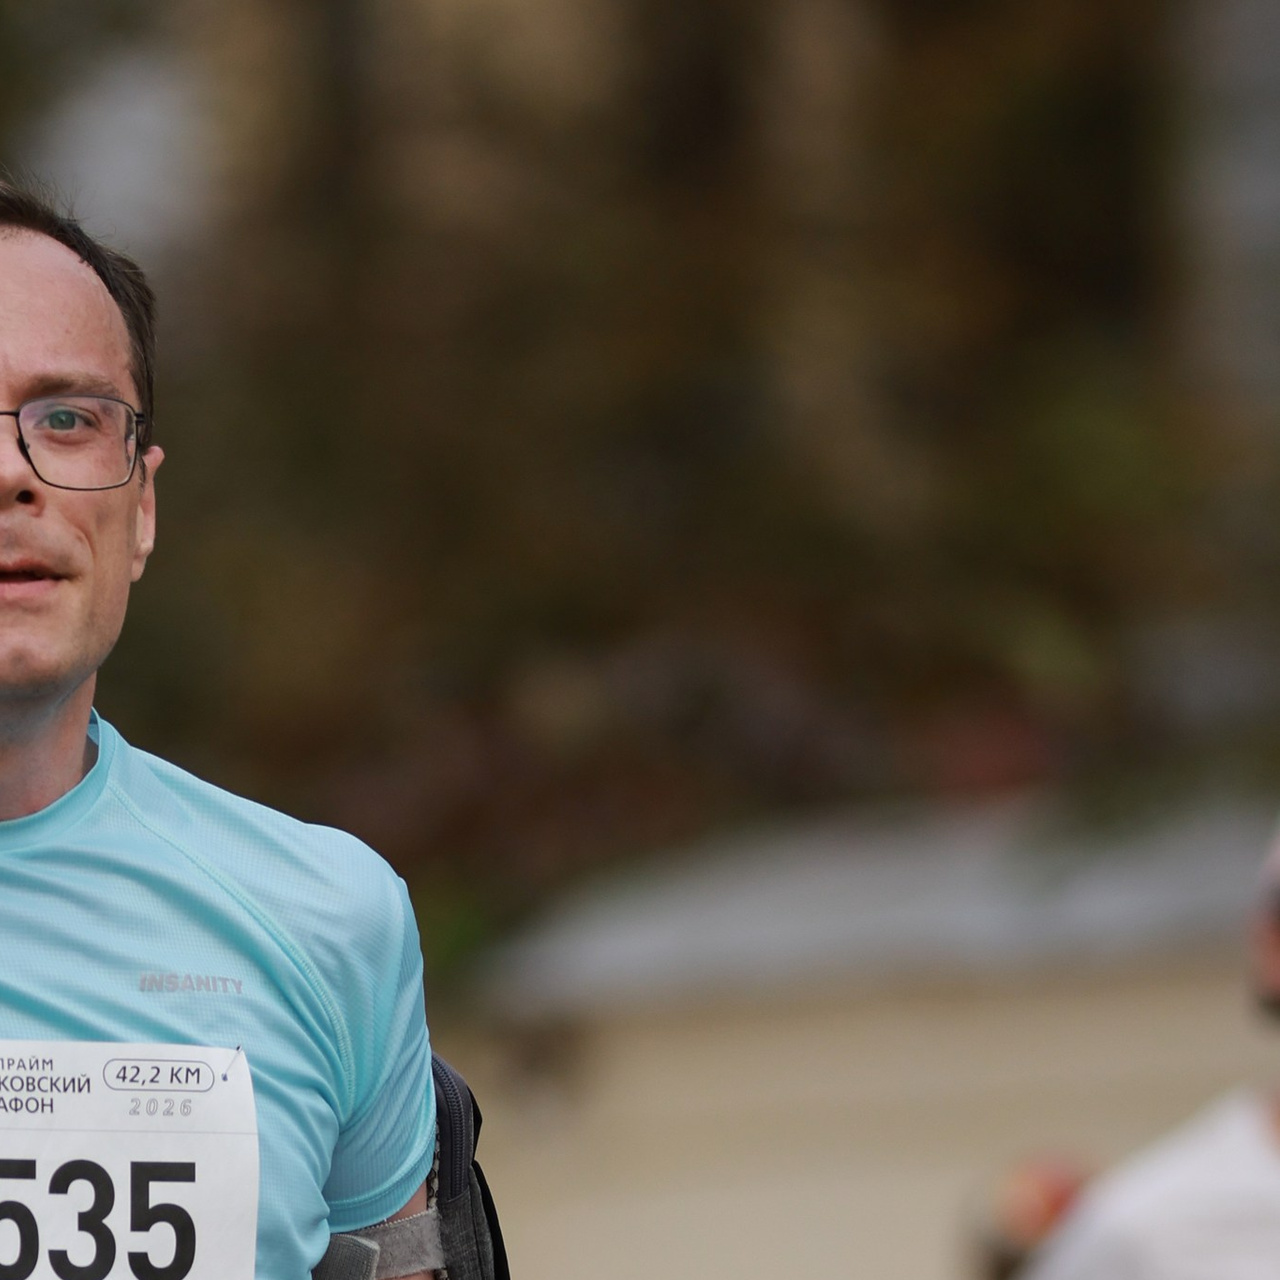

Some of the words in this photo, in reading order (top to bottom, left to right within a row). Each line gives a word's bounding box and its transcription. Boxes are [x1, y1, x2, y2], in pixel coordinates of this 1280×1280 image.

[139, 972, 243, 994] INSANITY
[115, 1065, 161, 1086] 42,2
[169, 1066, 201, 1084] КМ
[128, 1098, 193, 1117] 2026
